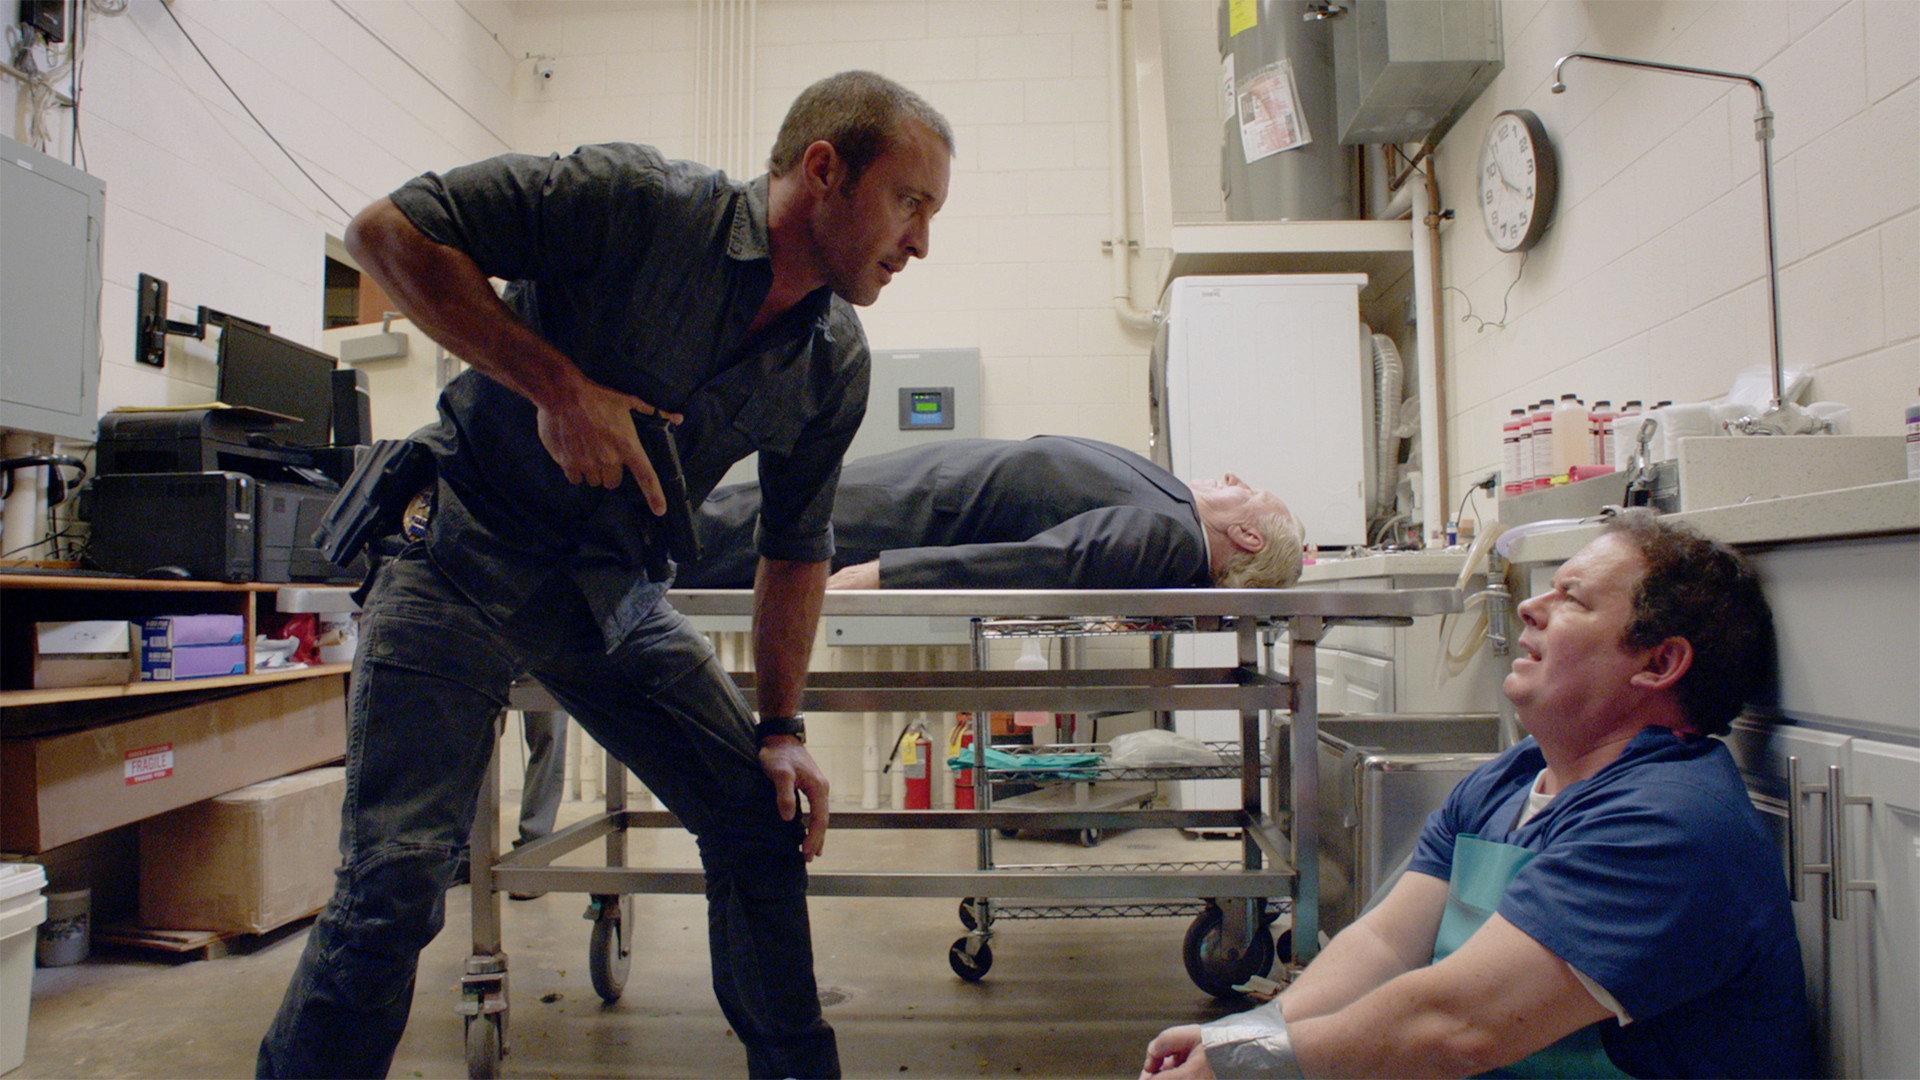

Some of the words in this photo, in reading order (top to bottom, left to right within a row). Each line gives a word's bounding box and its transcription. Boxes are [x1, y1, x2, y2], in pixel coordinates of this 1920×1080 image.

[1498, 125, 1509, 140] 12
[1519, 137, 1528, 153] 2
[1486, 162, 1496, 178] 10
[1527, 158, 1534, 175] 3
[1485, 190, 1493, 205] 9
[1526, 187, 1533, 200] 4
[1491, 211, 1499, 225] 8
[1519, 212, 1528, 226] 5
[1500, 223, 1507, 238] 7
[1510, 225, 1518, 239] 6
[131, 754, 167, 774] FRAGILE
